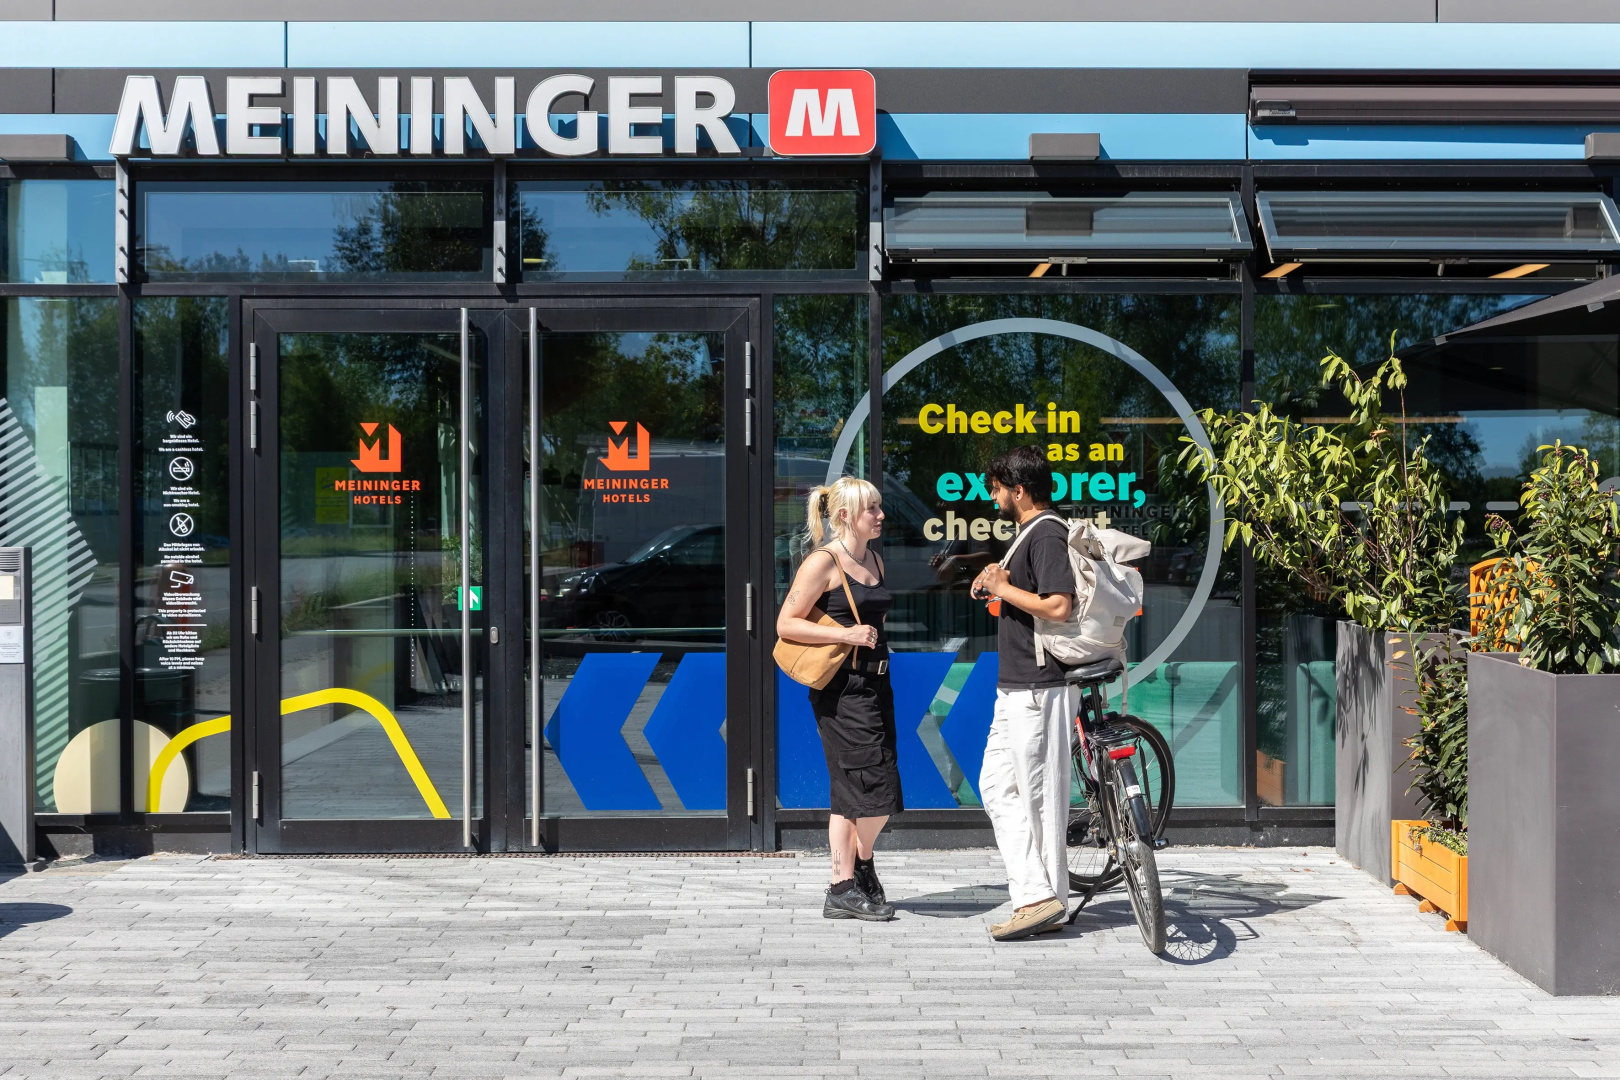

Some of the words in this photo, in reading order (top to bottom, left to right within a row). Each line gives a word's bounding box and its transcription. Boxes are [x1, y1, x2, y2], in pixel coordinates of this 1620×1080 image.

[109, 73, 742, 156] MEININGER
[785, 88, 860, 137] M
[918, 403, 1037, 435] Check
[1047, 402, 1081, 434] in
[1047, 443, 1080, 462] as
[1088, 443, 1124, 462] an
[334, 479, 421, 492] MEININGER
[583, 478, 670, 490] MEININGER
[936, 471, 1147, 509] exorer,
[353, 495, 402, 505] HOTELS
[602, 493, 651, 503] HOTELS
[1074, 505, 1178, 519] MEININGE
[923, 511, 1021, 542] chec
